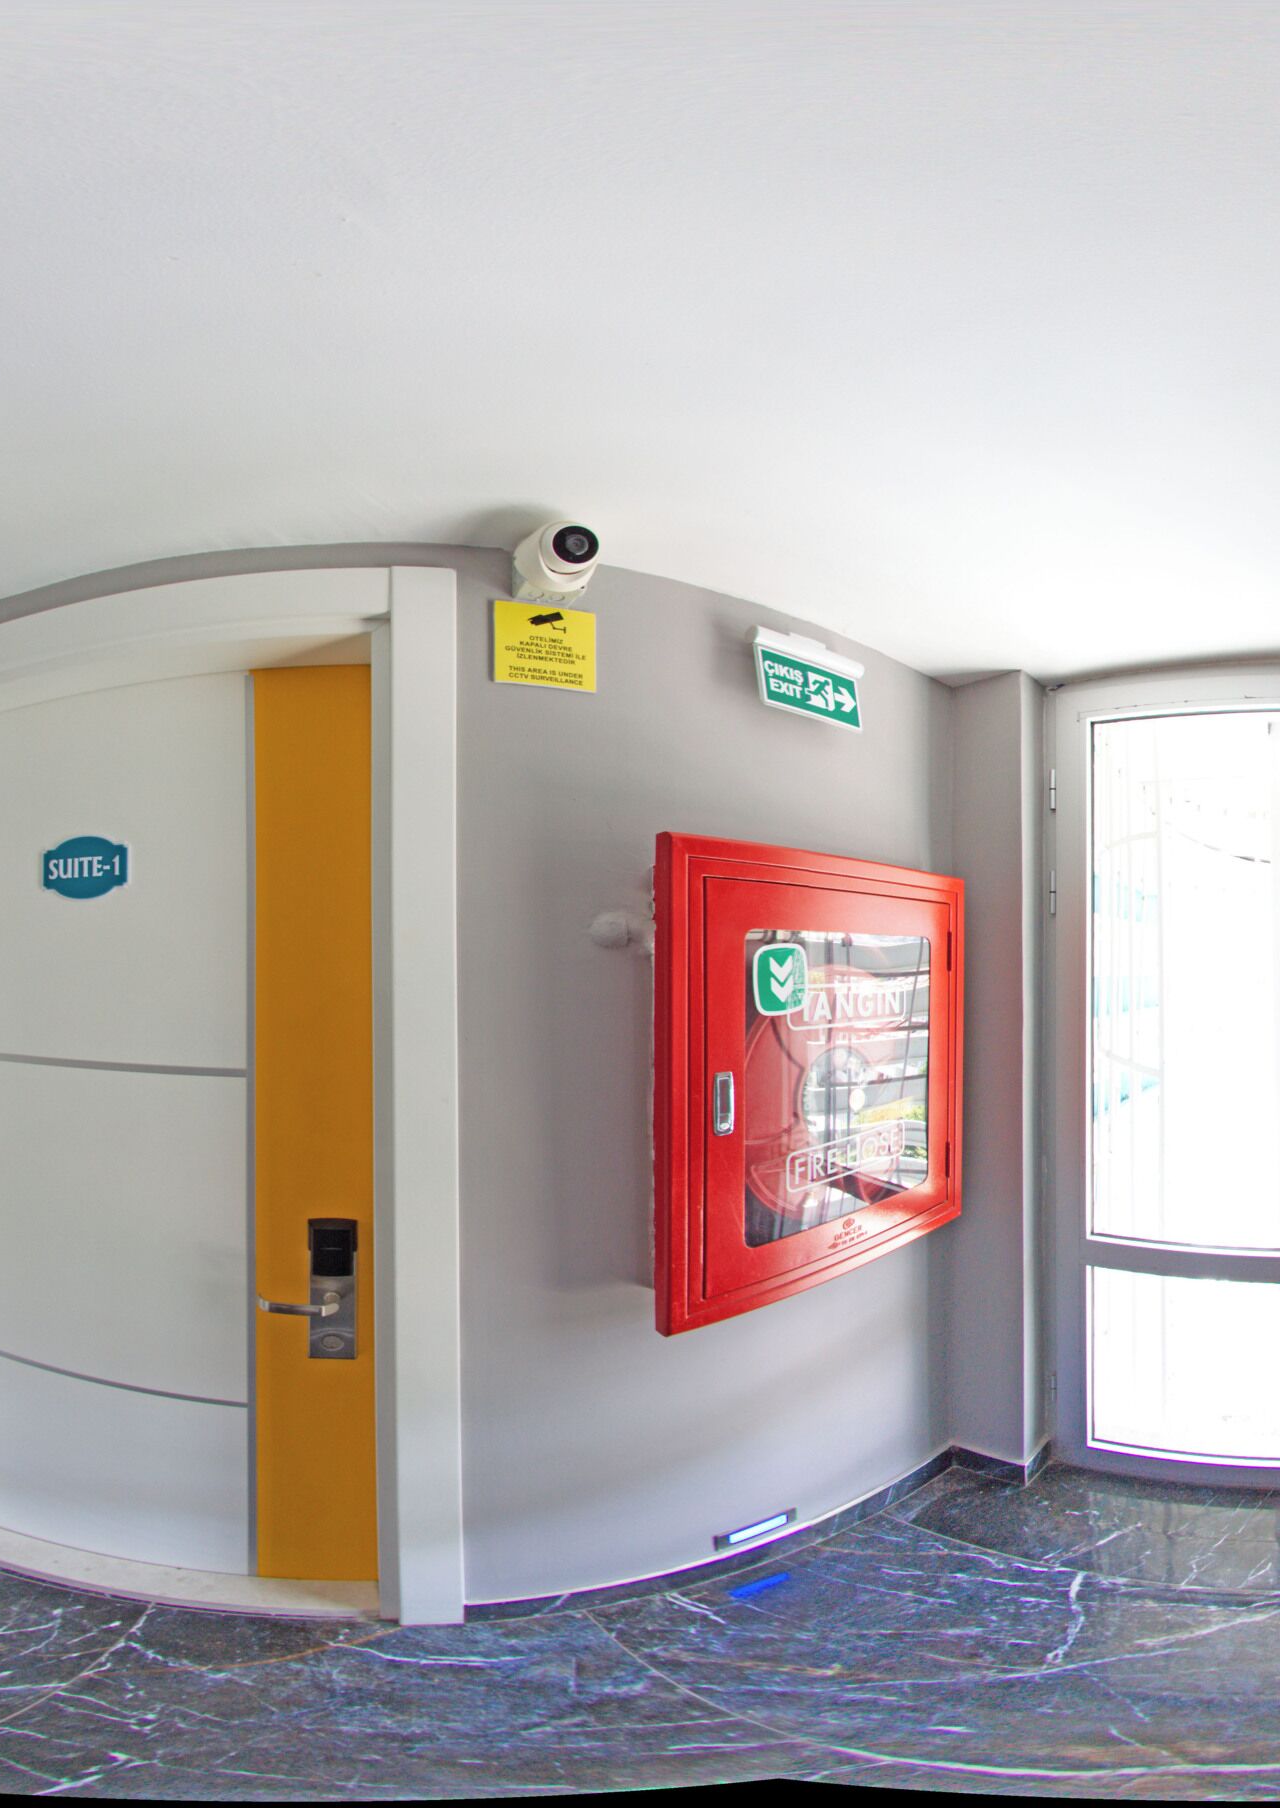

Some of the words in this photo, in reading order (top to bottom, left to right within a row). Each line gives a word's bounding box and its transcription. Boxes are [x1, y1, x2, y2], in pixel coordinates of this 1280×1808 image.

[519, 641, 547, 649] KAPALI
[548, 644, 572, 652] DEVRE
[531, 674, 583, 686] SURVEILLANCE
[558, 671, 583, 679] UNDER
[764, 660, 804, 686] ÇIKIŞ
[769, 677, 803, 699] EXIT
[48, 855, 120, 880] SUITE-1
[798, 988, 900, 1022] YANGIN
[795, 1148, 838, 1184] FIRE
[846, 1127, 899, 1167] HOSE
